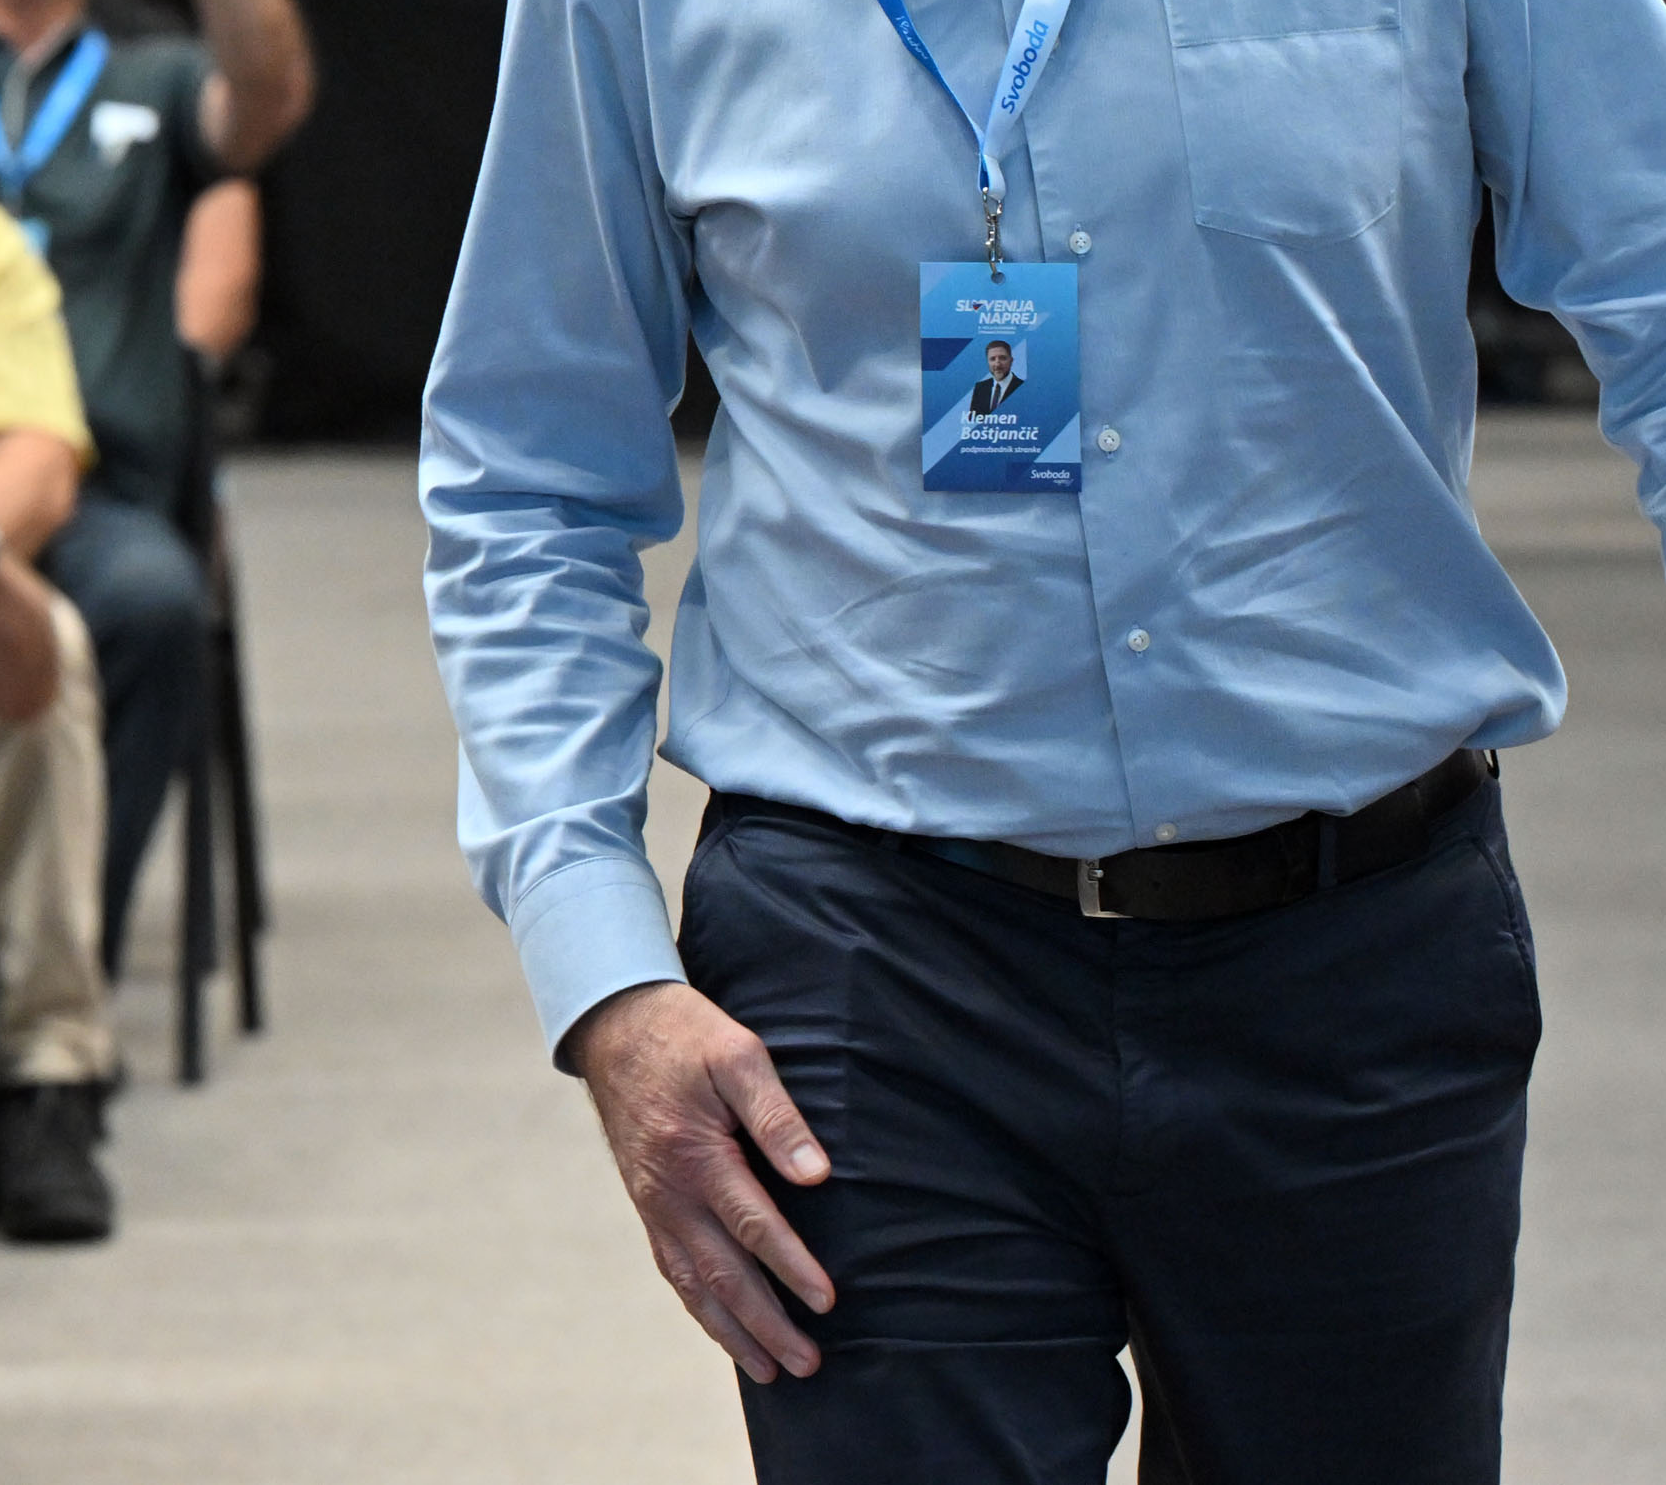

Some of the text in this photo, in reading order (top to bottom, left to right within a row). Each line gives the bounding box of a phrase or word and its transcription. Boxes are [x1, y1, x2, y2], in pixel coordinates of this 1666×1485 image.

[1001, 19, 1049, 114] Svoboda
[979, 312, 1037, 325] NAPREJ
[960, 410, 1017, 425] Klemen
[960, 426, 1039, 443] Boštjančič
[1030, 469, 1070, 479] Svoboda
